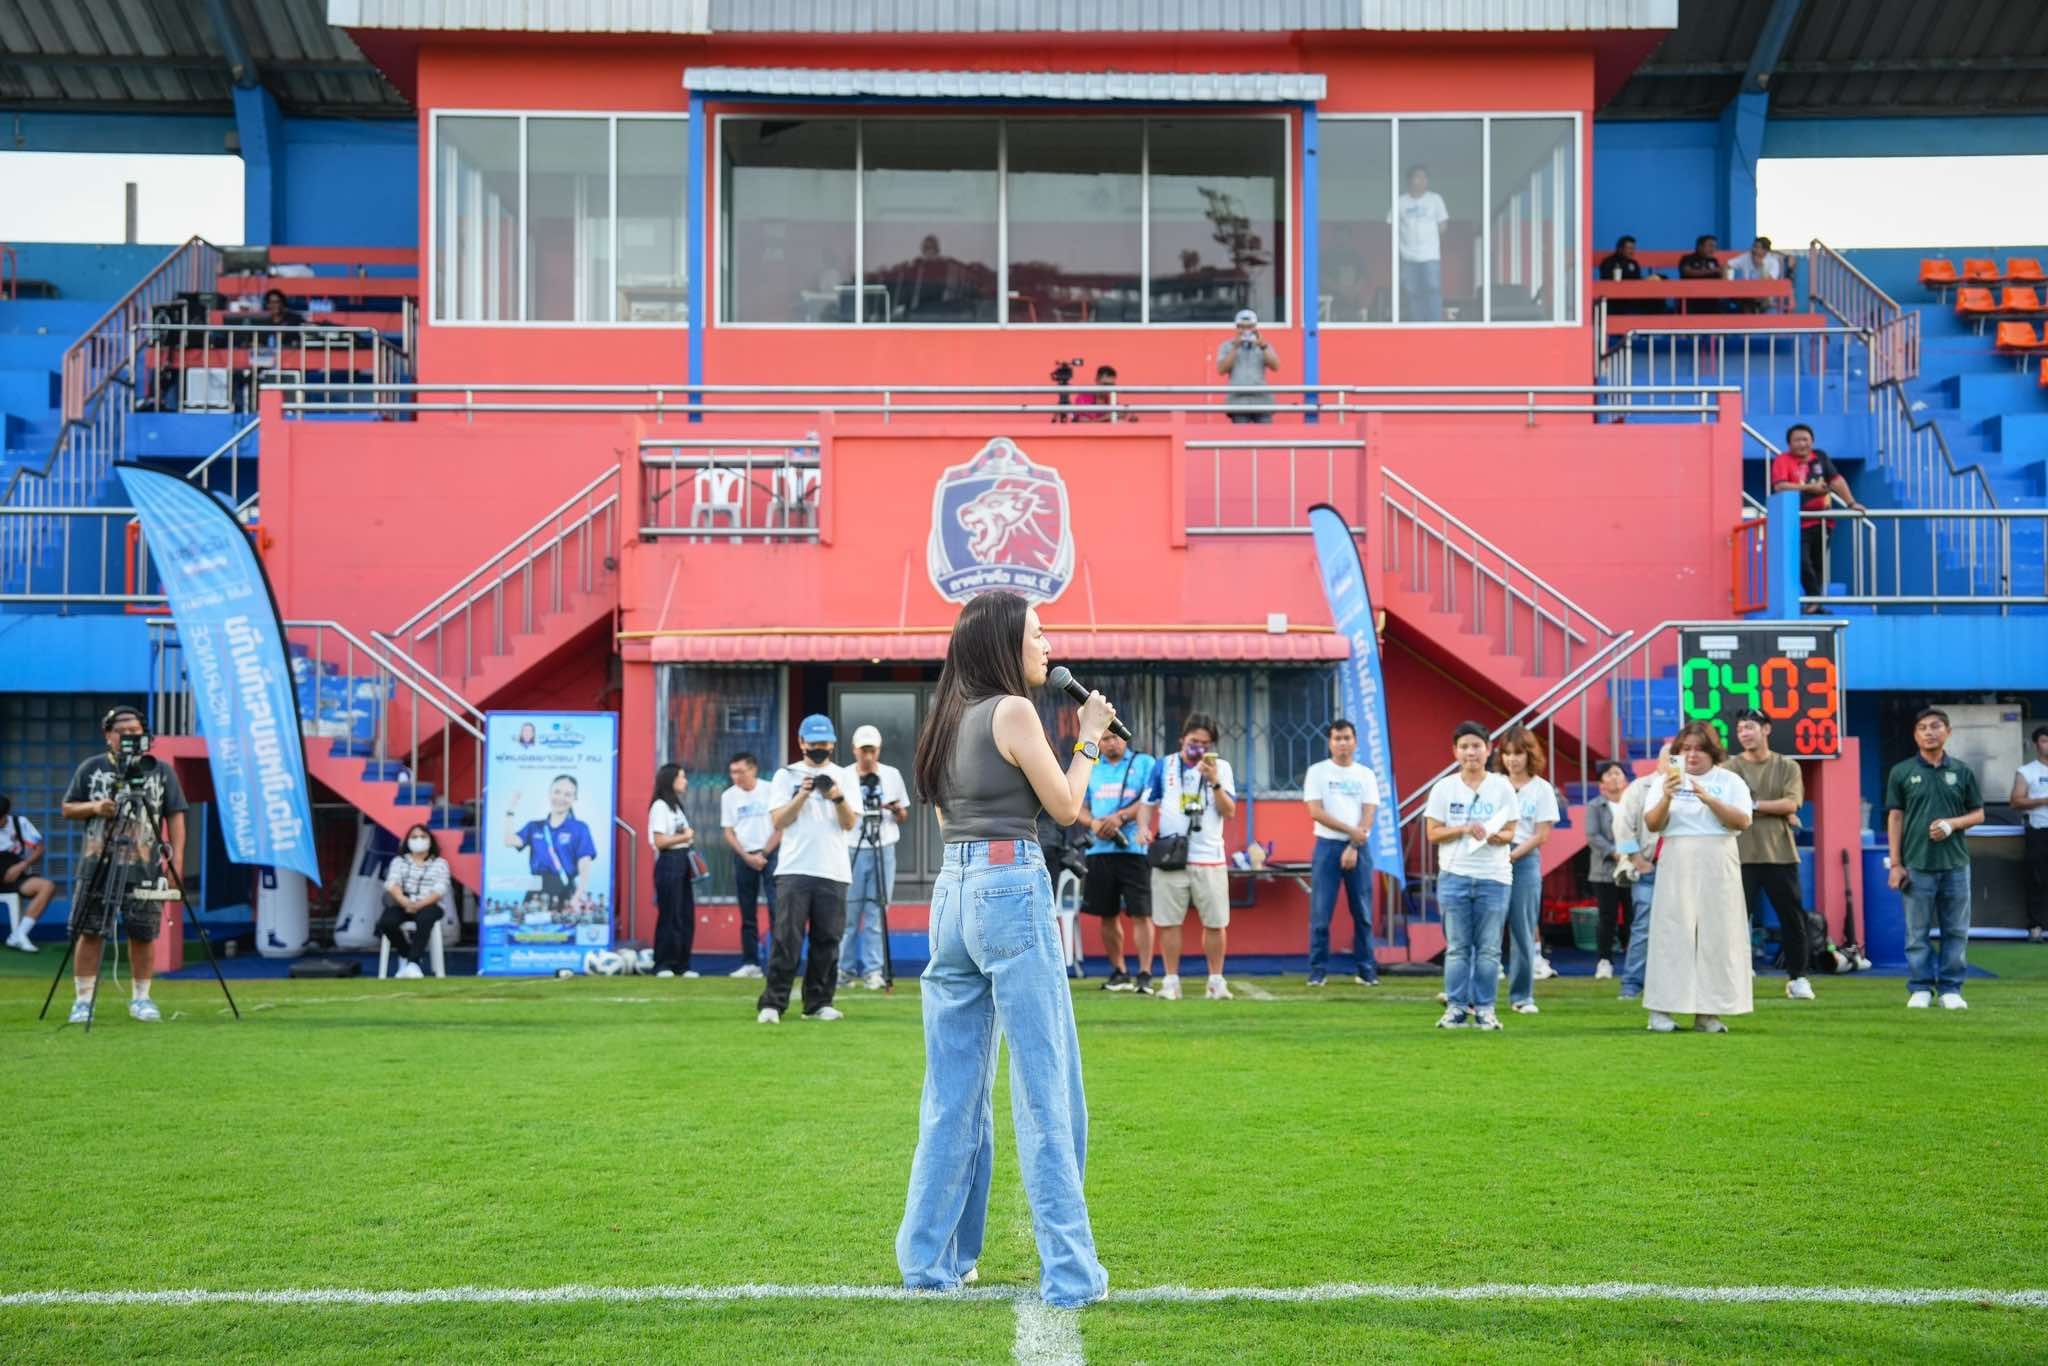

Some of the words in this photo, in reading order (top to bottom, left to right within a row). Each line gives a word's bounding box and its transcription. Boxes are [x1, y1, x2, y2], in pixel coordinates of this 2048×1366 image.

[1683, 657, 1760, 719] 04
[1760, 657, 1838, 719] 03
[1795, 718, 1838, 754] 00
